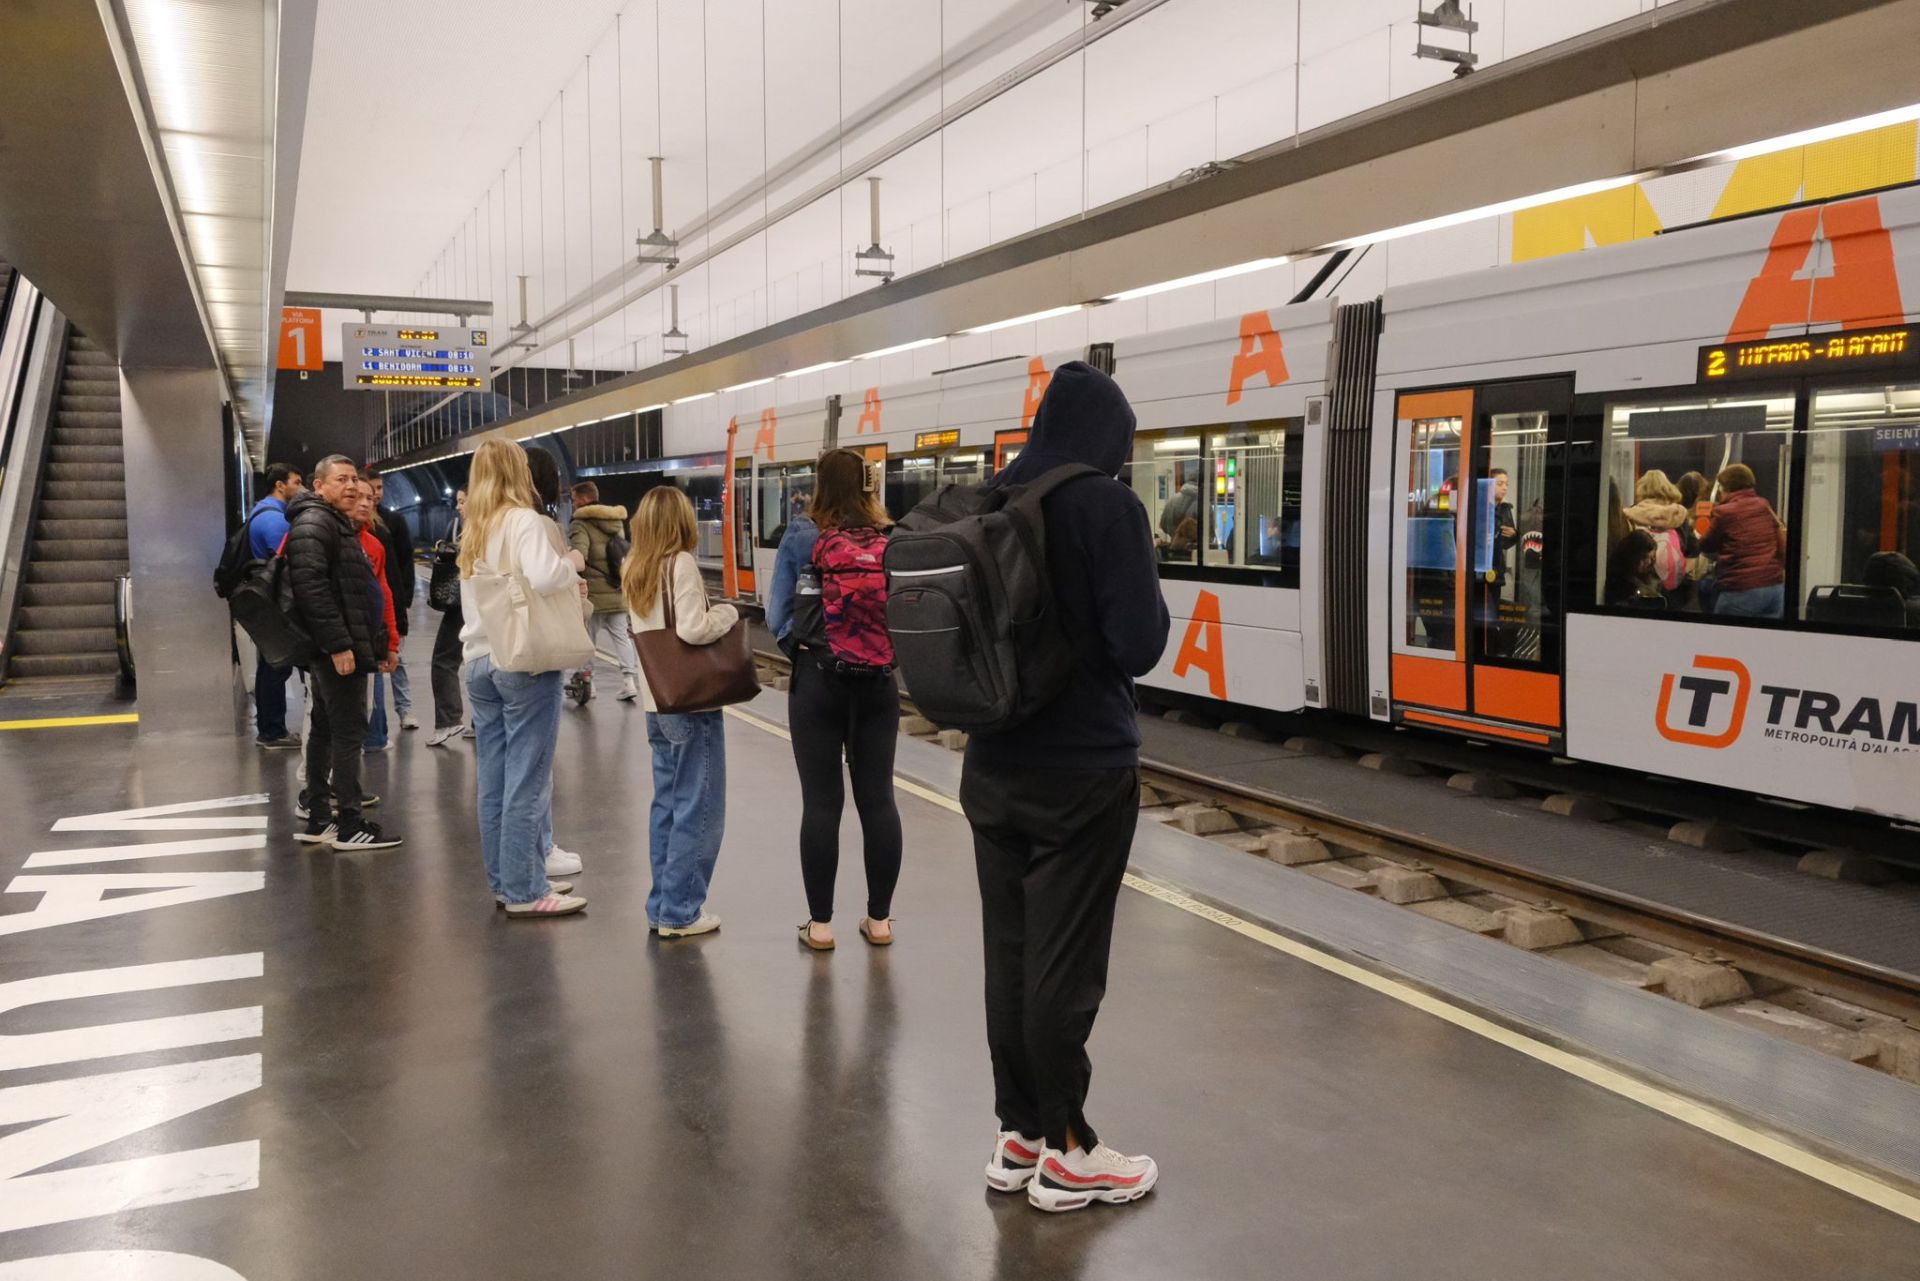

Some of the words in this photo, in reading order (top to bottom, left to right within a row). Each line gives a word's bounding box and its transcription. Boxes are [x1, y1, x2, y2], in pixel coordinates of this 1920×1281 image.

[288, 327, 305, 366] 1
[1706, 351, 1726, 376] 2
[0, 951, 264, 1281] UN
